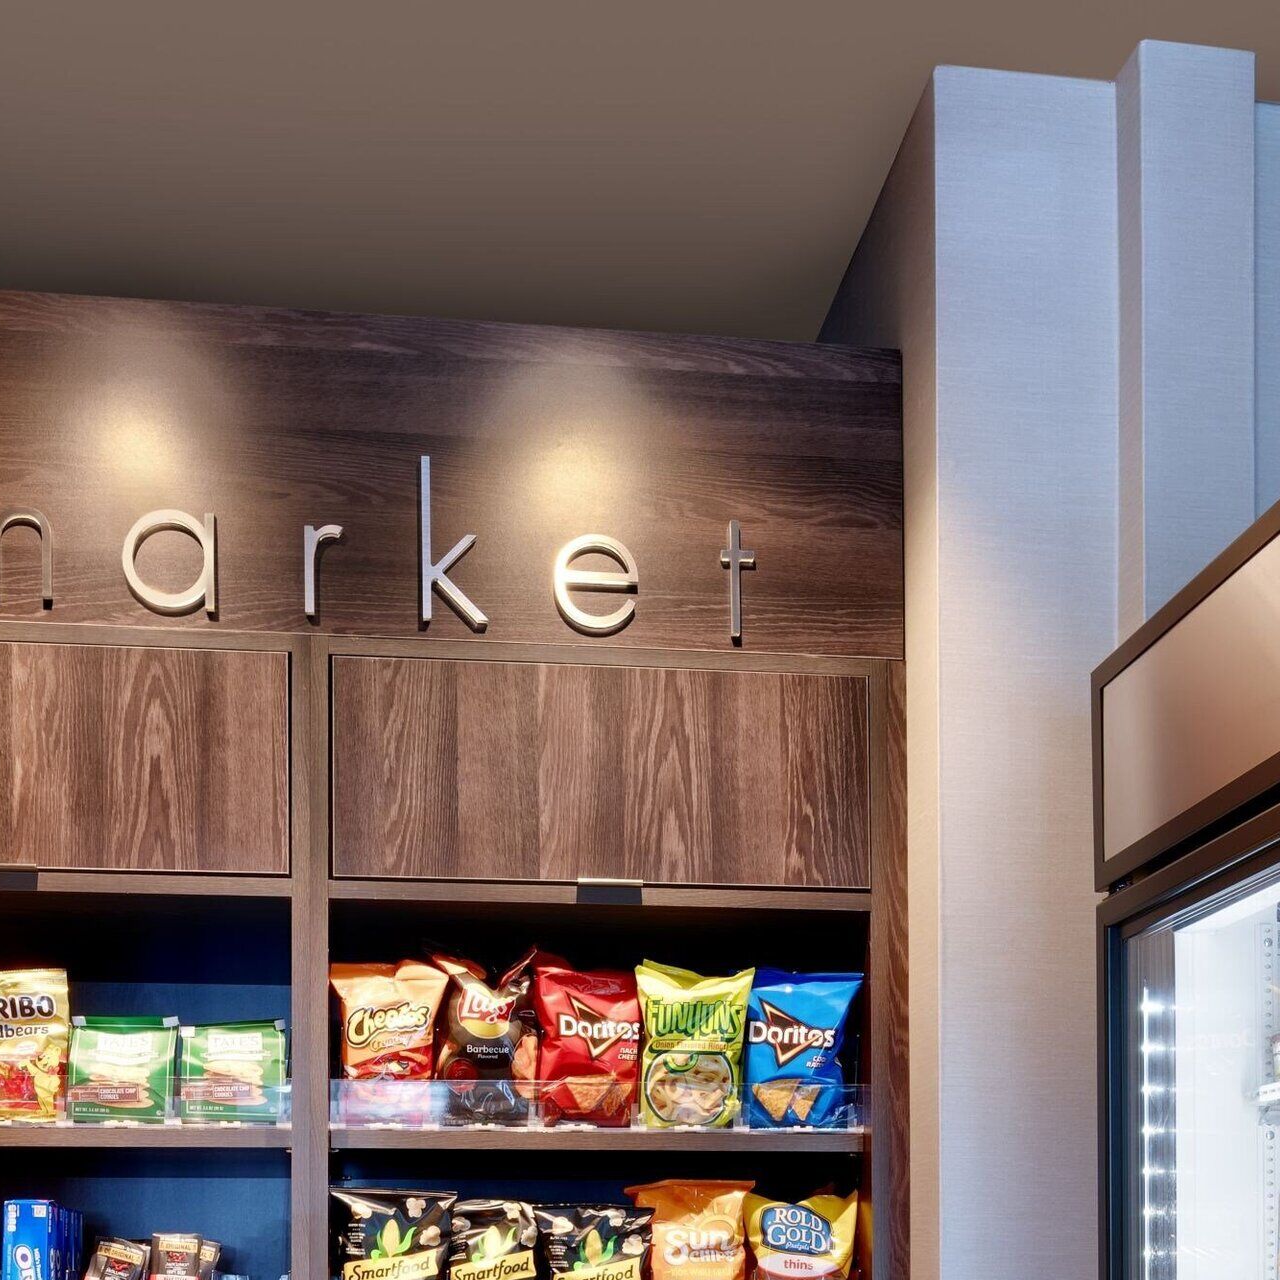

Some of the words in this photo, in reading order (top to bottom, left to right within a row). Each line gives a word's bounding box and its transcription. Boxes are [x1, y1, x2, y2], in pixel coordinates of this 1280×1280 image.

[348, 1002, 430, 1046] Cheetos
[559, 1014, 640, 1040] Doritos
[749, 1021, 835, 1048] Doritos
[466, 1044, 509, 1054] Barbecue
[774, 1207, 824, 1232] ROLD
[768, 1224, 827, 1252] GOLD
[783, 1258, 813, 1271] thins
